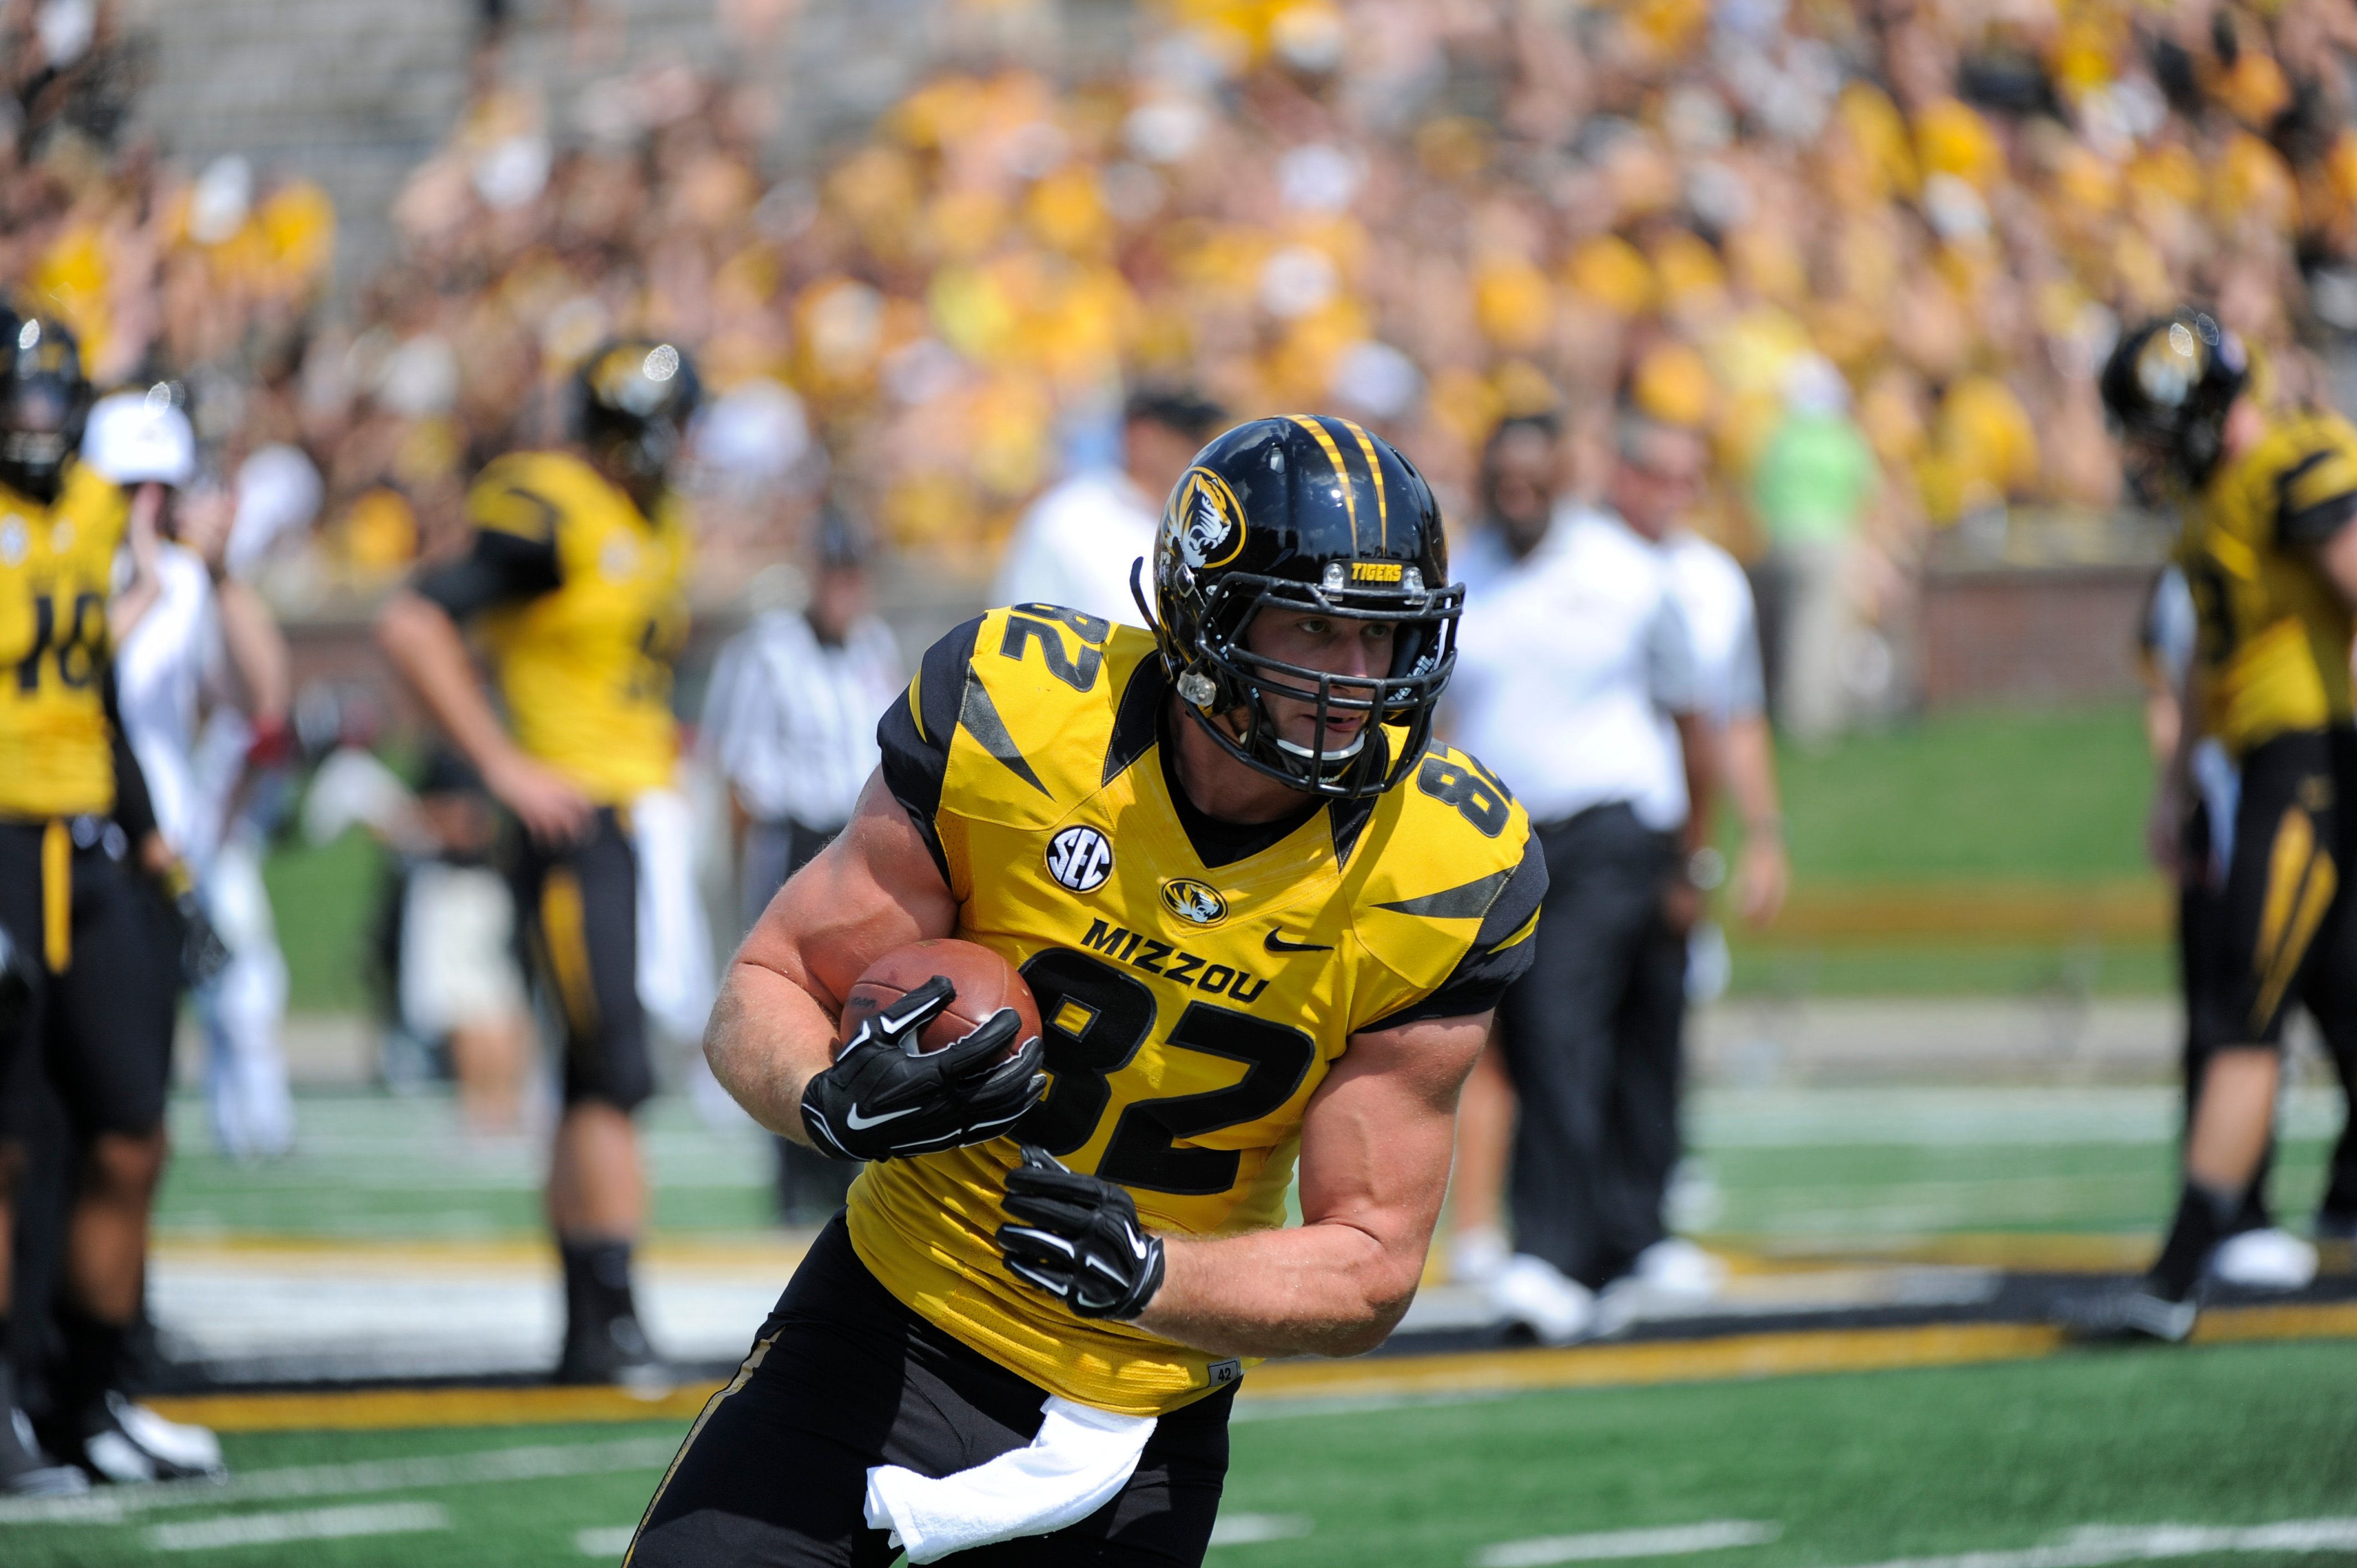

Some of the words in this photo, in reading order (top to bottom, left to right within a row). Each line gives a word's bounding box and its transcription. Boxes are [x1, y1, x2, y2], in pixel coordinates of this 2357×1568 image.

[1351, 563, 1403, 582] TIGERS
[1000, 602, 1110, 693] 82
[1049, 828, 1110, 890] SEC
[1080, 917, 1270, 1003] MIZZOU
[1003, 947, 1316, 1196] 82
[1218, 1367, 1232, 1382] 42
